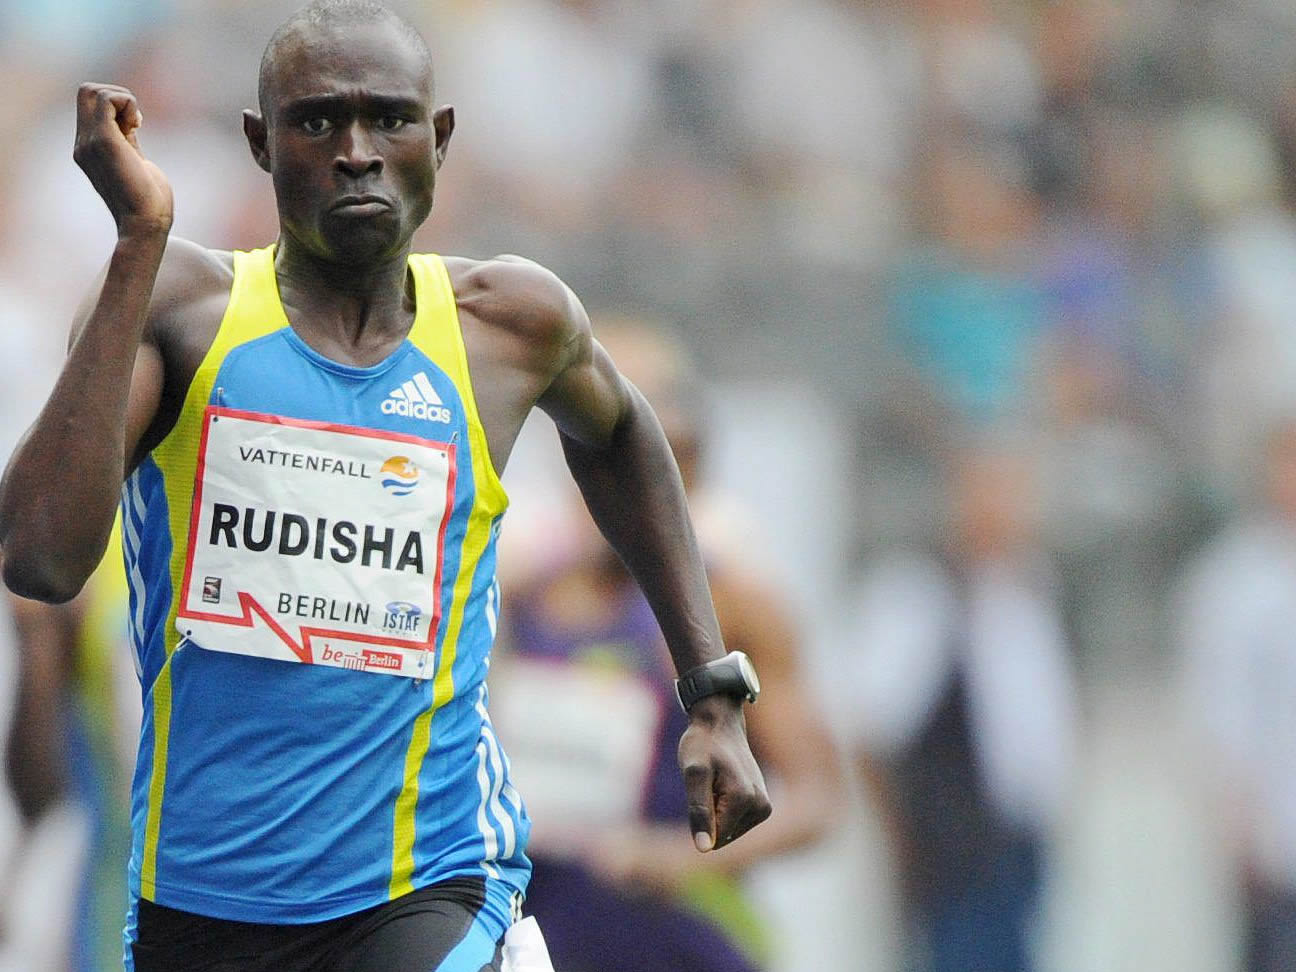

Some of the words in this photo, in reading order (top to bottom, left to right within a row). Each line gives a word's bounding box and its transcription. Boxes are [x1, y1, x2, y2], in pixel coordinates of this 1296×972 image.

[381, 399, 451, 424] adidas
[239, 446, 371, 478] VATTENFALL
[209, 503, 424, 574] RUDISHA
[277, 592, 370, 624] BERLIN
[383, 612, 420, 631] ISTAF
[322, 644, 344, 662] be
[368, 653, 400, 667] Berlin
